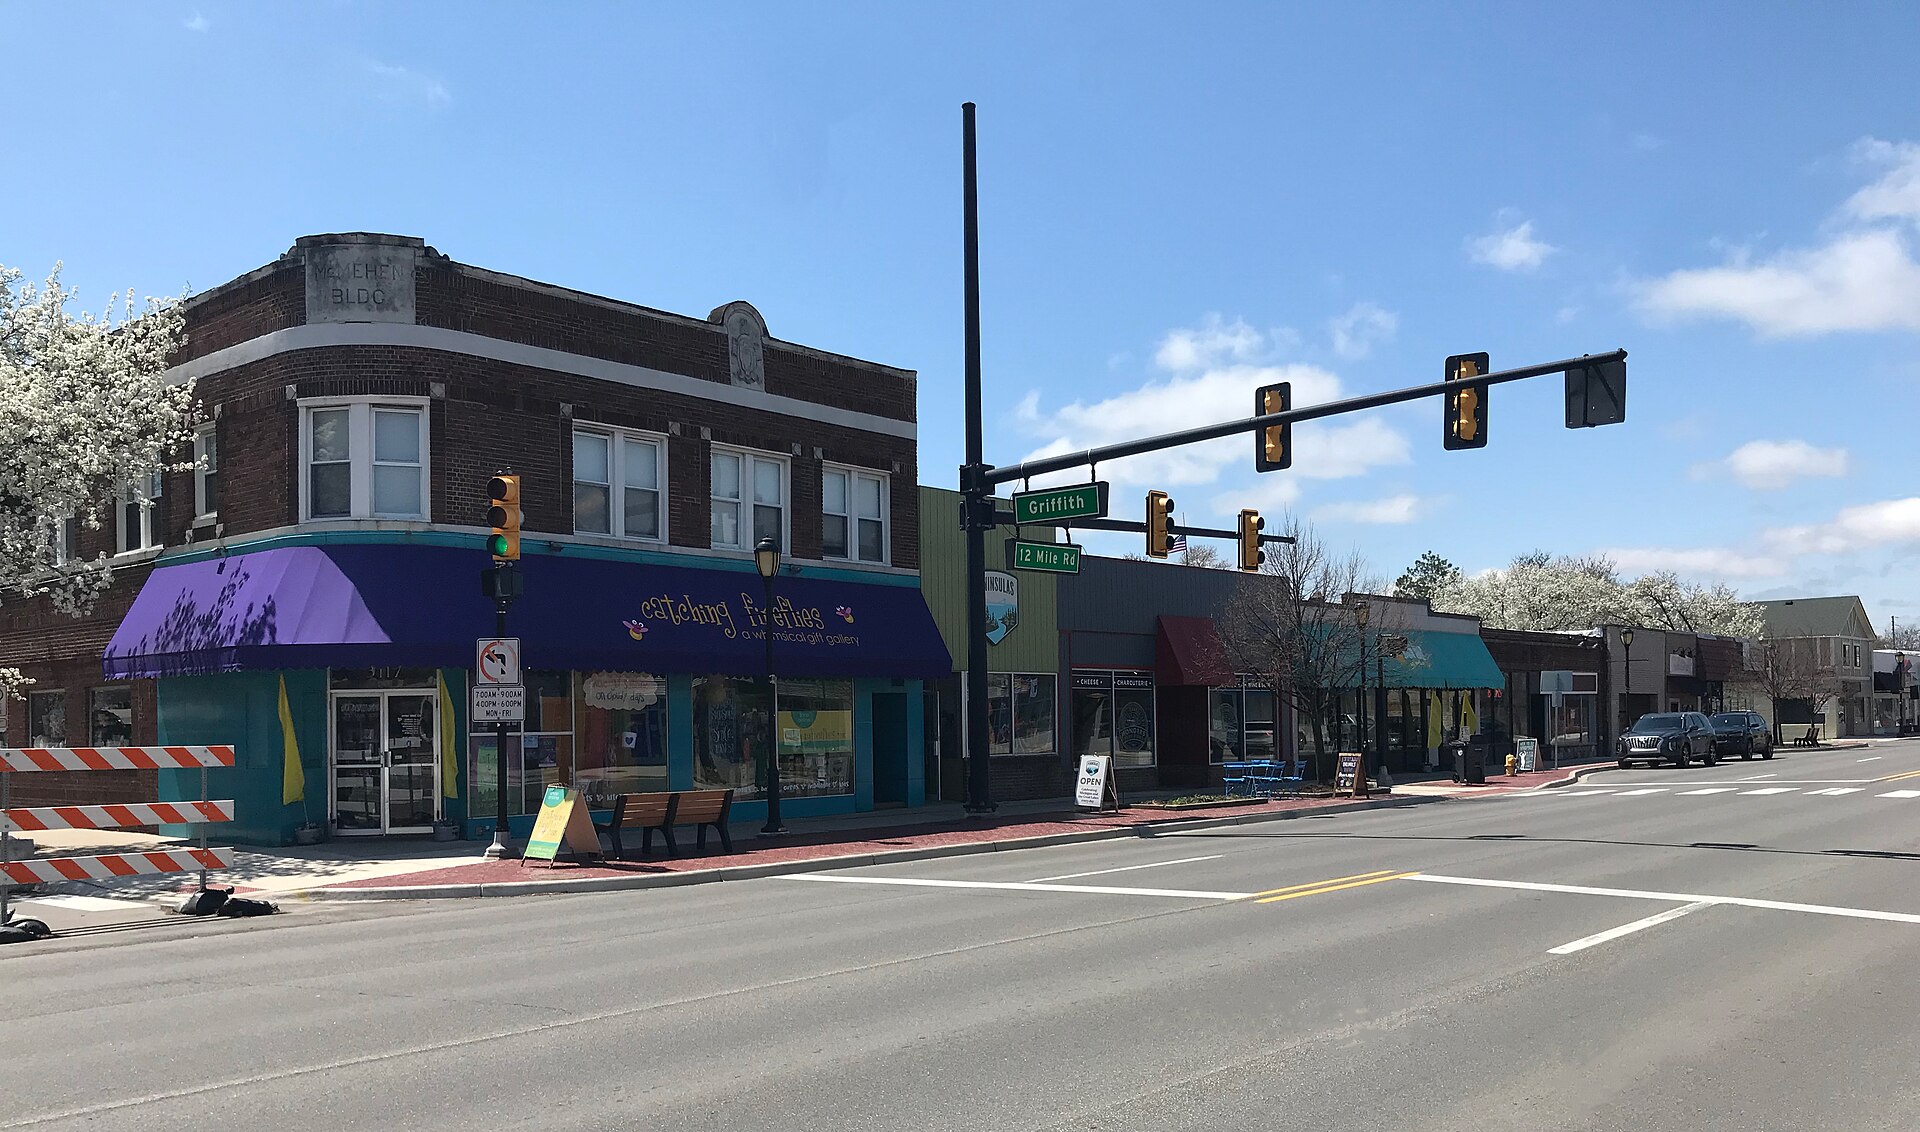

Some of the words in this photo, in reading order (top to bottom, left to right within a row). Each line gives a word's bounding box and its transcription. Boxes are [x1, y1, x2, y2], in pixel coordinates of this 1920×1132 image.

[1029, 495, 1084, 515] Griffith
[1019, 548, 1031, 562] 12
[1036, 550, 1058, 565] Mile
[1063, 552, 1075, 566] Rd
[985, 576, 1015, 596] INSULAS
[641, 594, 737, 639] catching
[740, 592, 825, 630] fireflies
[741, 630, 751, 640] a
[751, 629, 807, 643] whmsical
[807, 632, 825, 645] gift
[826, 634, 860, 648] gallery
[1080, 678, 1100, 686] CHEESE
[1080, 777, 1102, 786] OPEN
